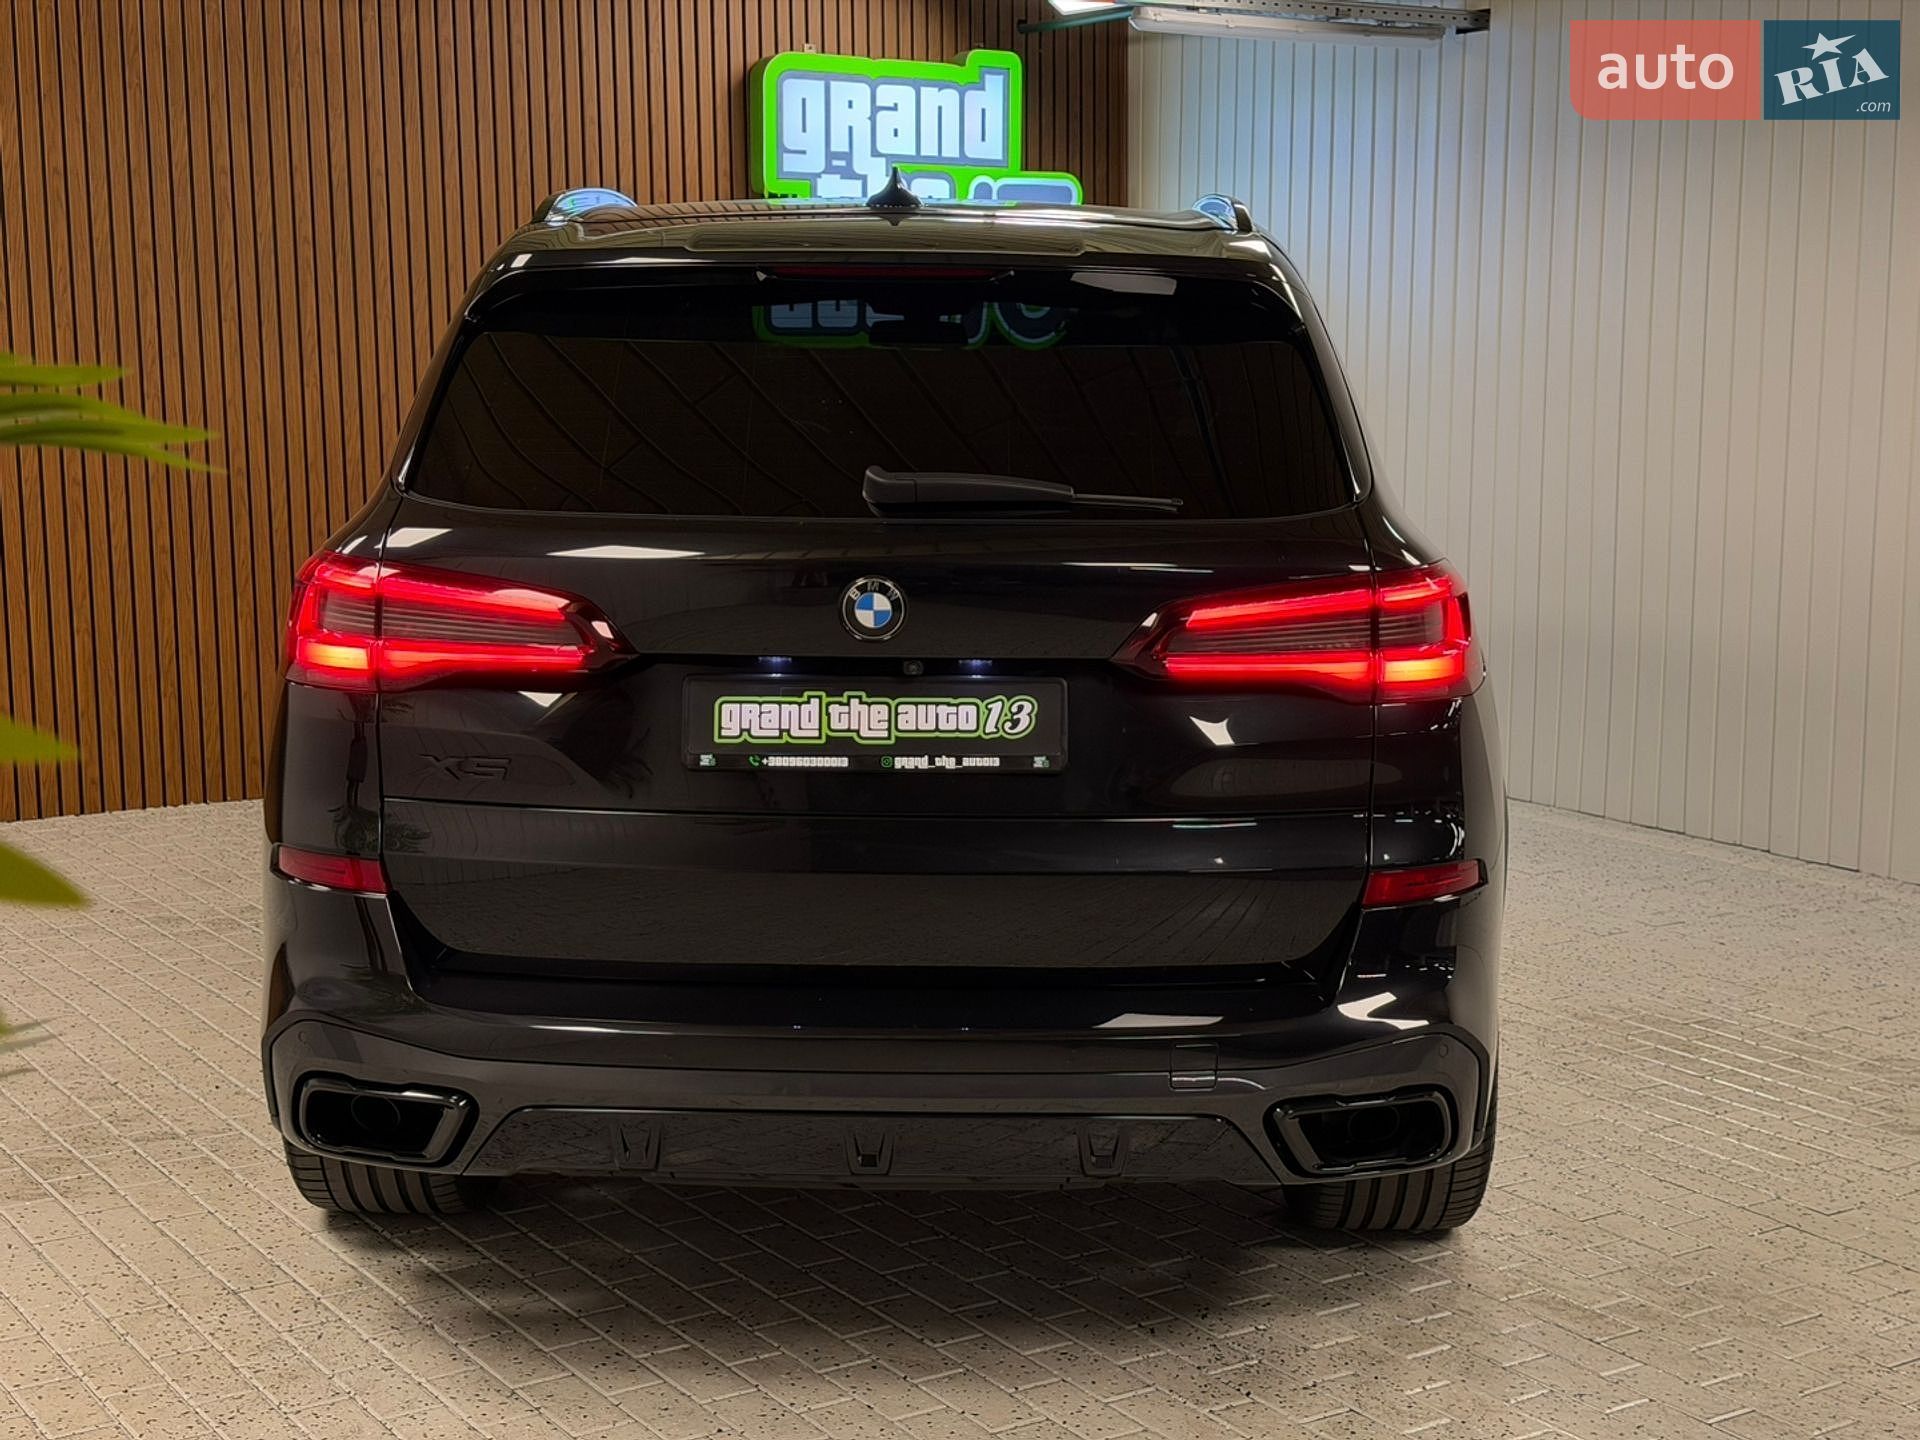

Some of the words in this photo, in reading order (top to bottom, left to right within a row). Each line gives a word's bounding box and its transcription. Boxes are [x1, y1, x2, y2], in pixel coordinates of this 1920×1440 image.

[849, 580, 900, 602] BMW
[827, 698, 889, 737] the
[897, 702, 979, 732] auto
[983, 700, 1034, 735] 13
[416, 753, 512, 782] X5
